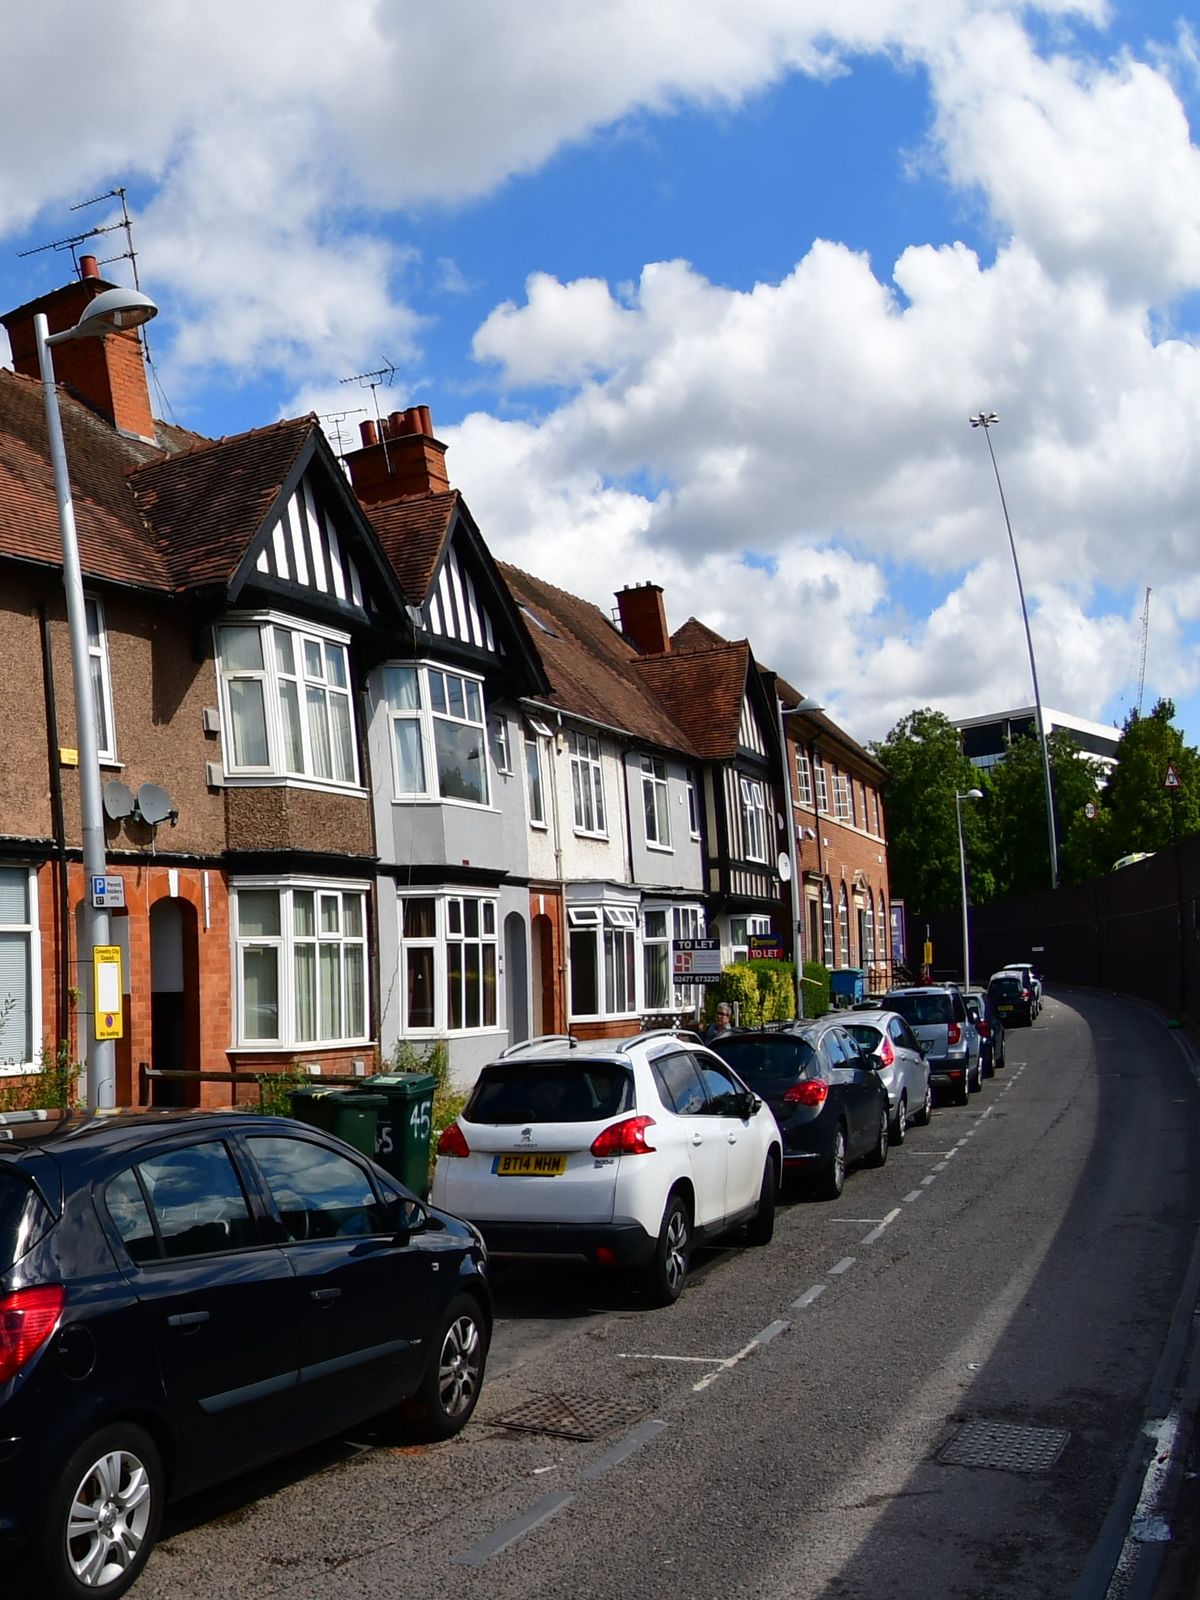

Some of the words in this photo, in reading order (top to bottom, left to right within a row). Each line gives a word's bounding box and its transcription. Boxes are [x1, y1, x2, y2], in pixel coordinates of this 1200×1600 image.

[96, 879, 104, 894] P
[678, 940, 692, 949] TO
[695, 940, 714, 949] LET
[752, 949, 762, 958] TO
[763, 949, 778, 958] LET
[409, 1101, 431, 1139] 45
[502, 1156, 531, 1172] BT14
[533, 1156, 562, 1172] MHM
